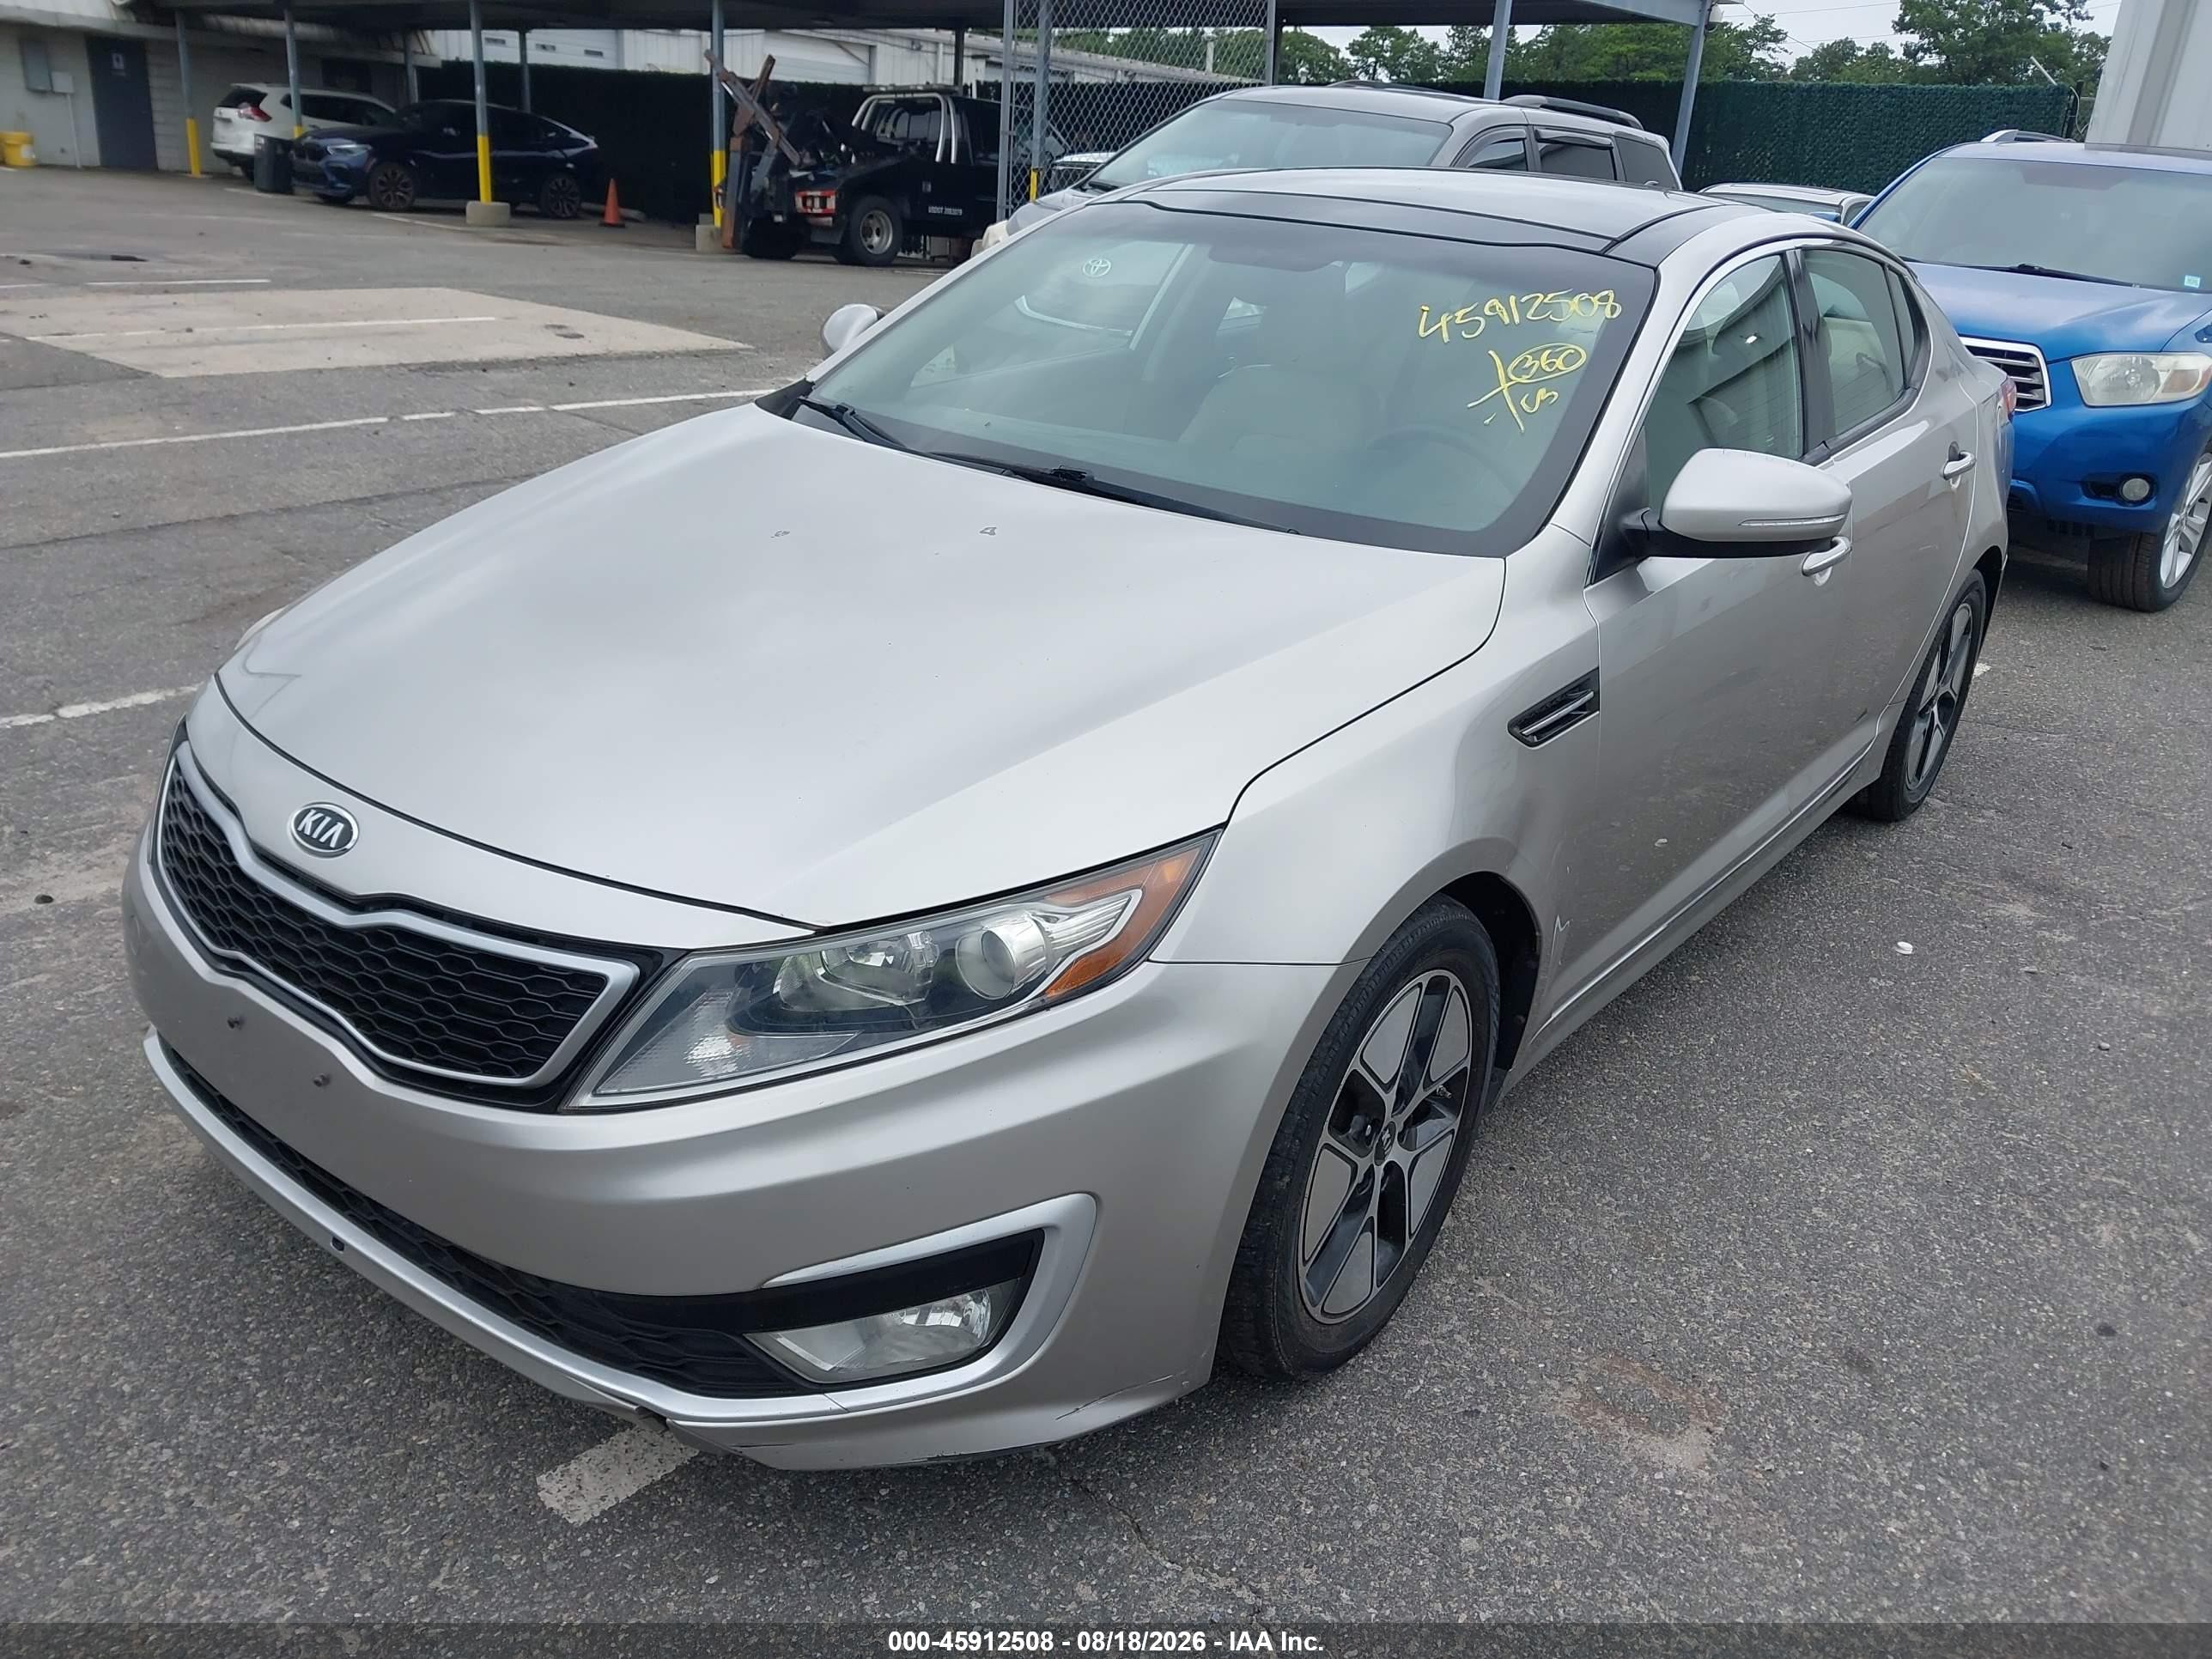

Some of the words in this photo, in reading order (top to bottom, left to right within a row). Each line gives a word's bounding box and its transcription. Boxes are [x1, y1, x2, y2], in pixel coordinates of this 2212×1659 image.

[1418, 289, 1623, 343] 45912508
[1514, 348, 1575, 380] 360
[296, 809, 344, 848] KIA
